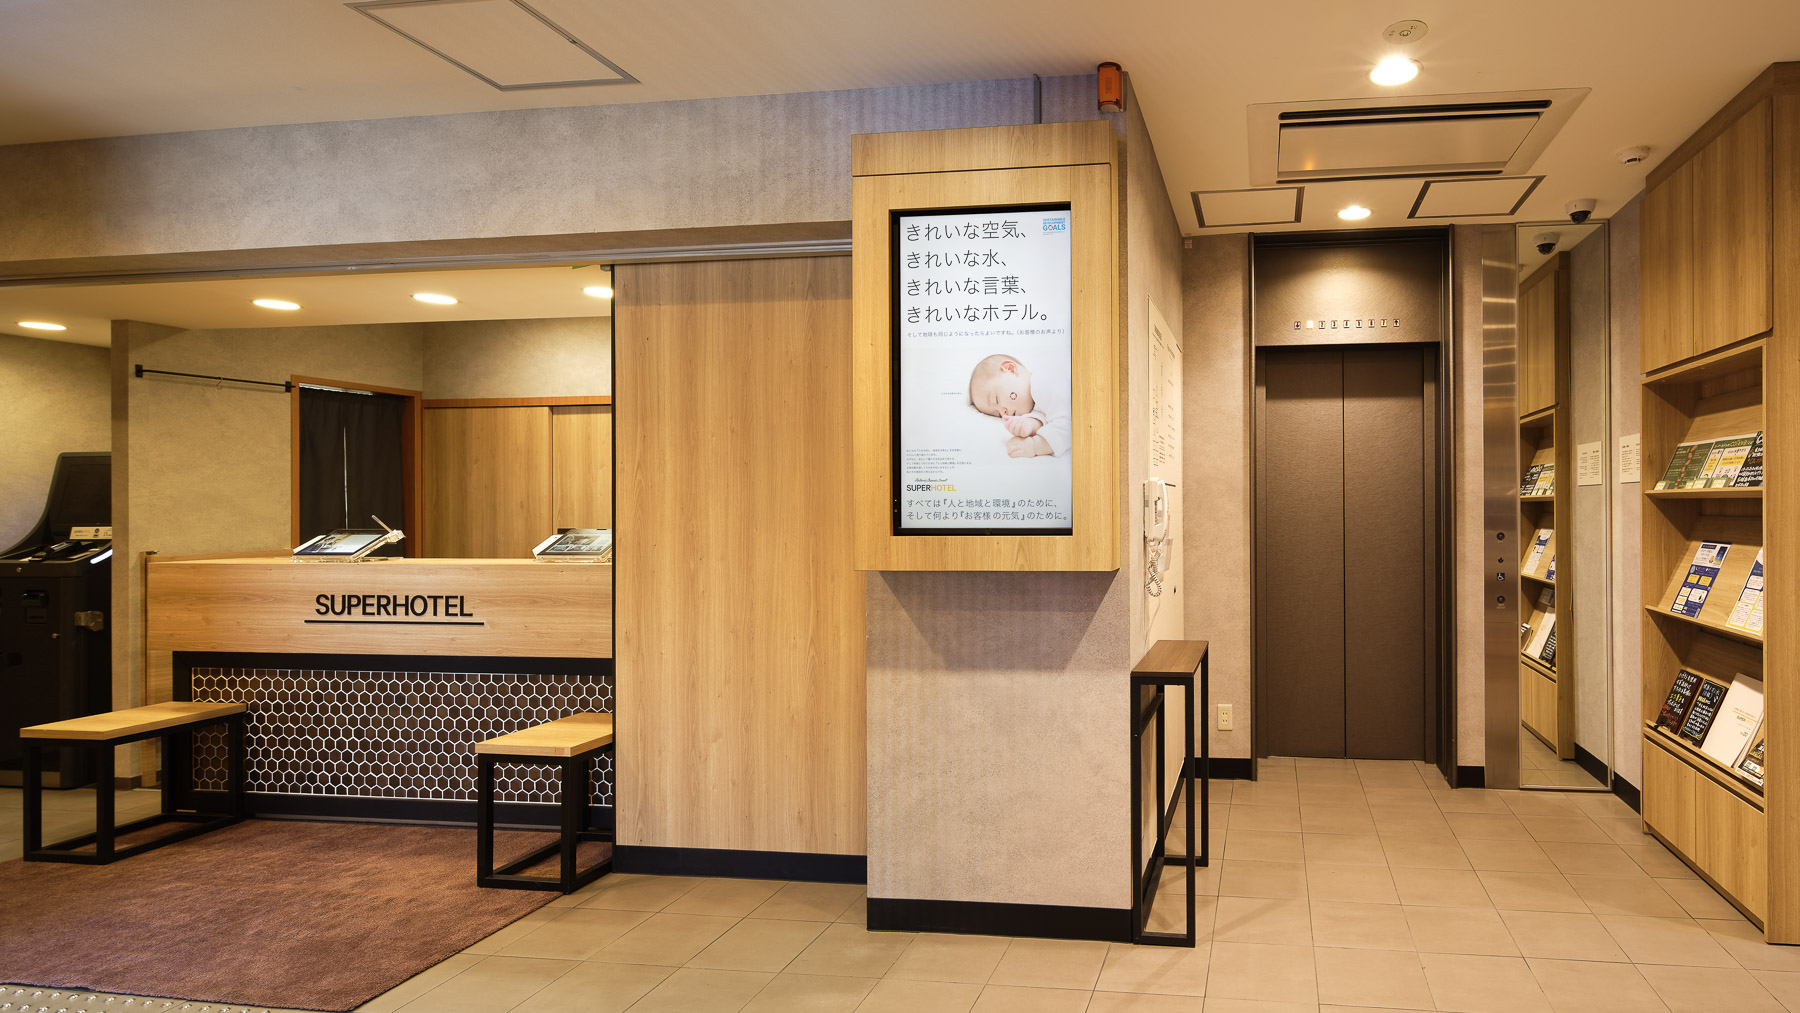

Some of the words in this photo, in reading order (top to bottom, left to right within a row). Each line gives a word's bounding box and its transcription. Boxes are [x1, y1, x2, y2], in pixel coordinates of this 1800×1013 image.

[906, 220, 1026, 242] きれいな空気、
[906, 248, 1007, 269] きれいな水、
[907, 275, 1026, 296] きれいな言葉、
[907, 303, 1048, 324] きれいなホテル。
[906, 484, 957, 492] SUPERHOTEL
[315, 593, 474, 617] SUPERHOTEL
